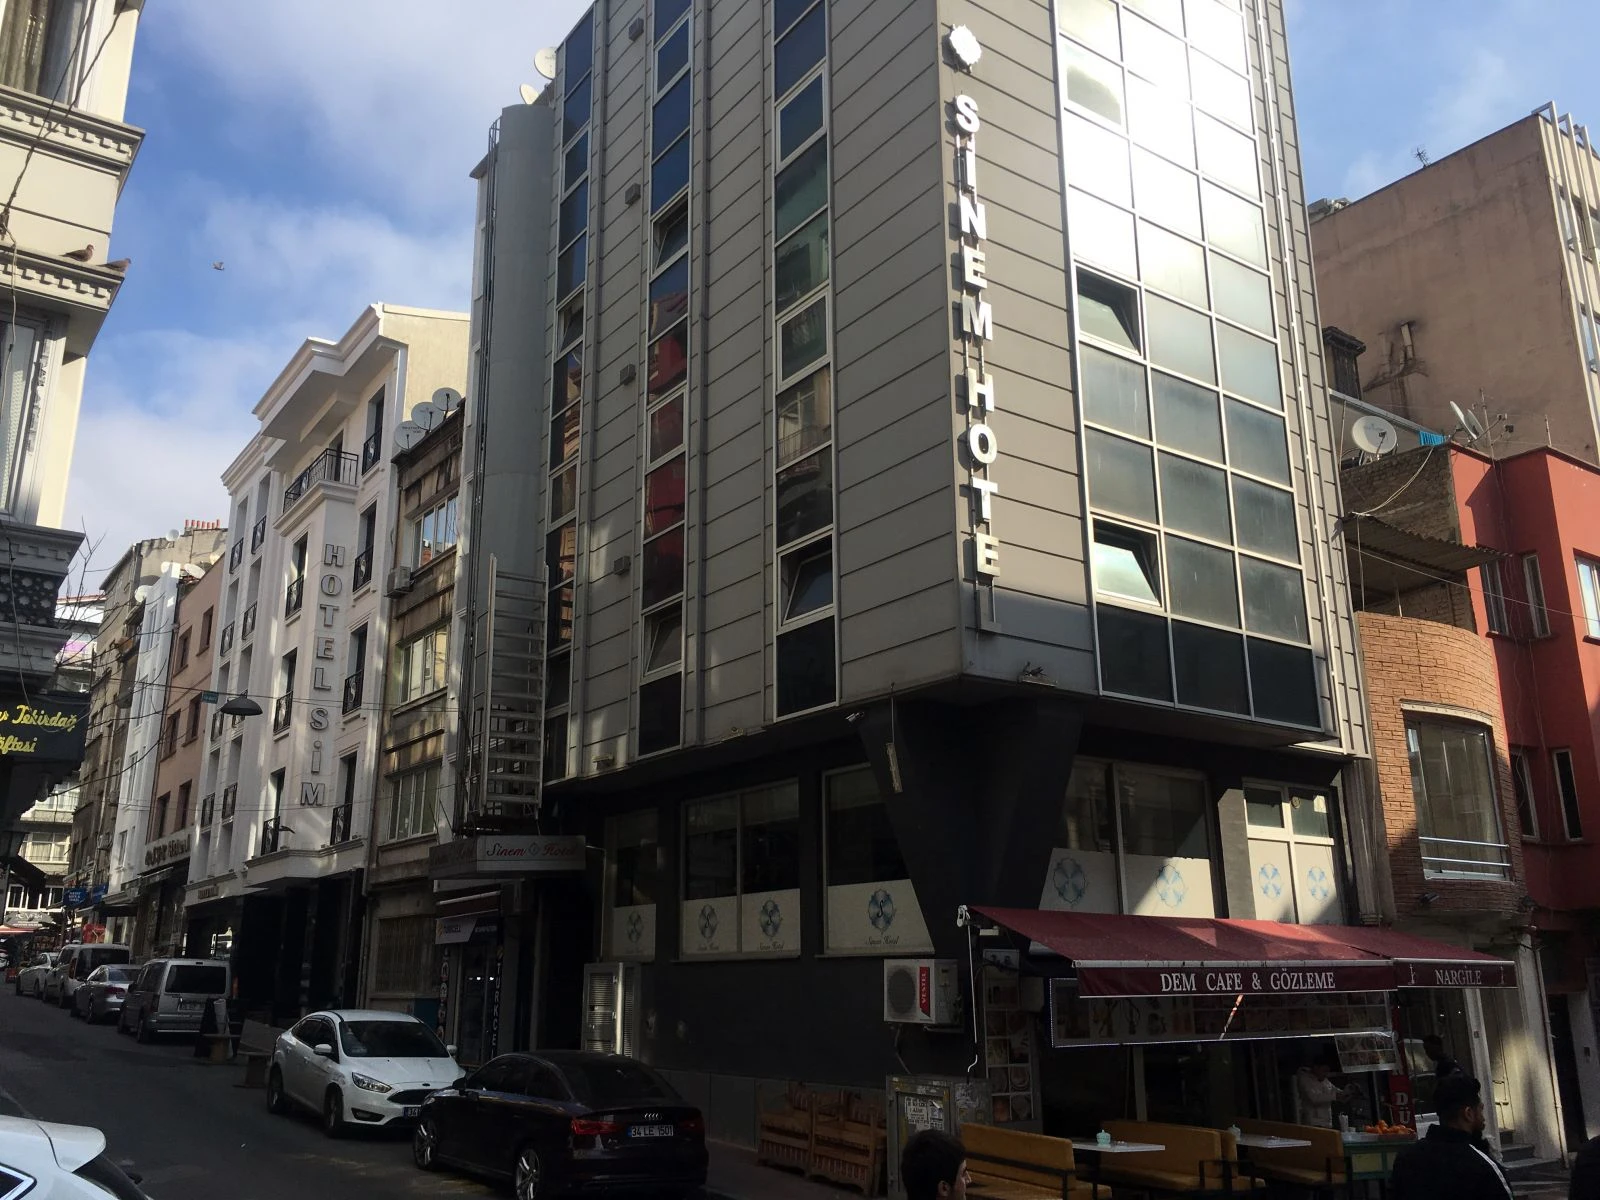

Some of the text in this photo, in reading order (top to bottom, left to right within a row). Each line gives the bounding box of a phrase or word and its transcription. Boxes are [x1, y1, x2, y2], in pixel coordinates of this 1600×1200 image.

[966, 366, 1001, 577] HOTE
[313, 543, 346, 691] HOTEL
[12, 704, 78, 733] Tekirdağ
[486, 842, 527, 857] Sinem
[1159, 967, 1336, 992] DEM CAFE & GÖZLEME
[1434, 964, 1482, 985] NARGİLE
[632, 1127, 642, 1137] 34
[643, 1126, 655, 1136] LE
